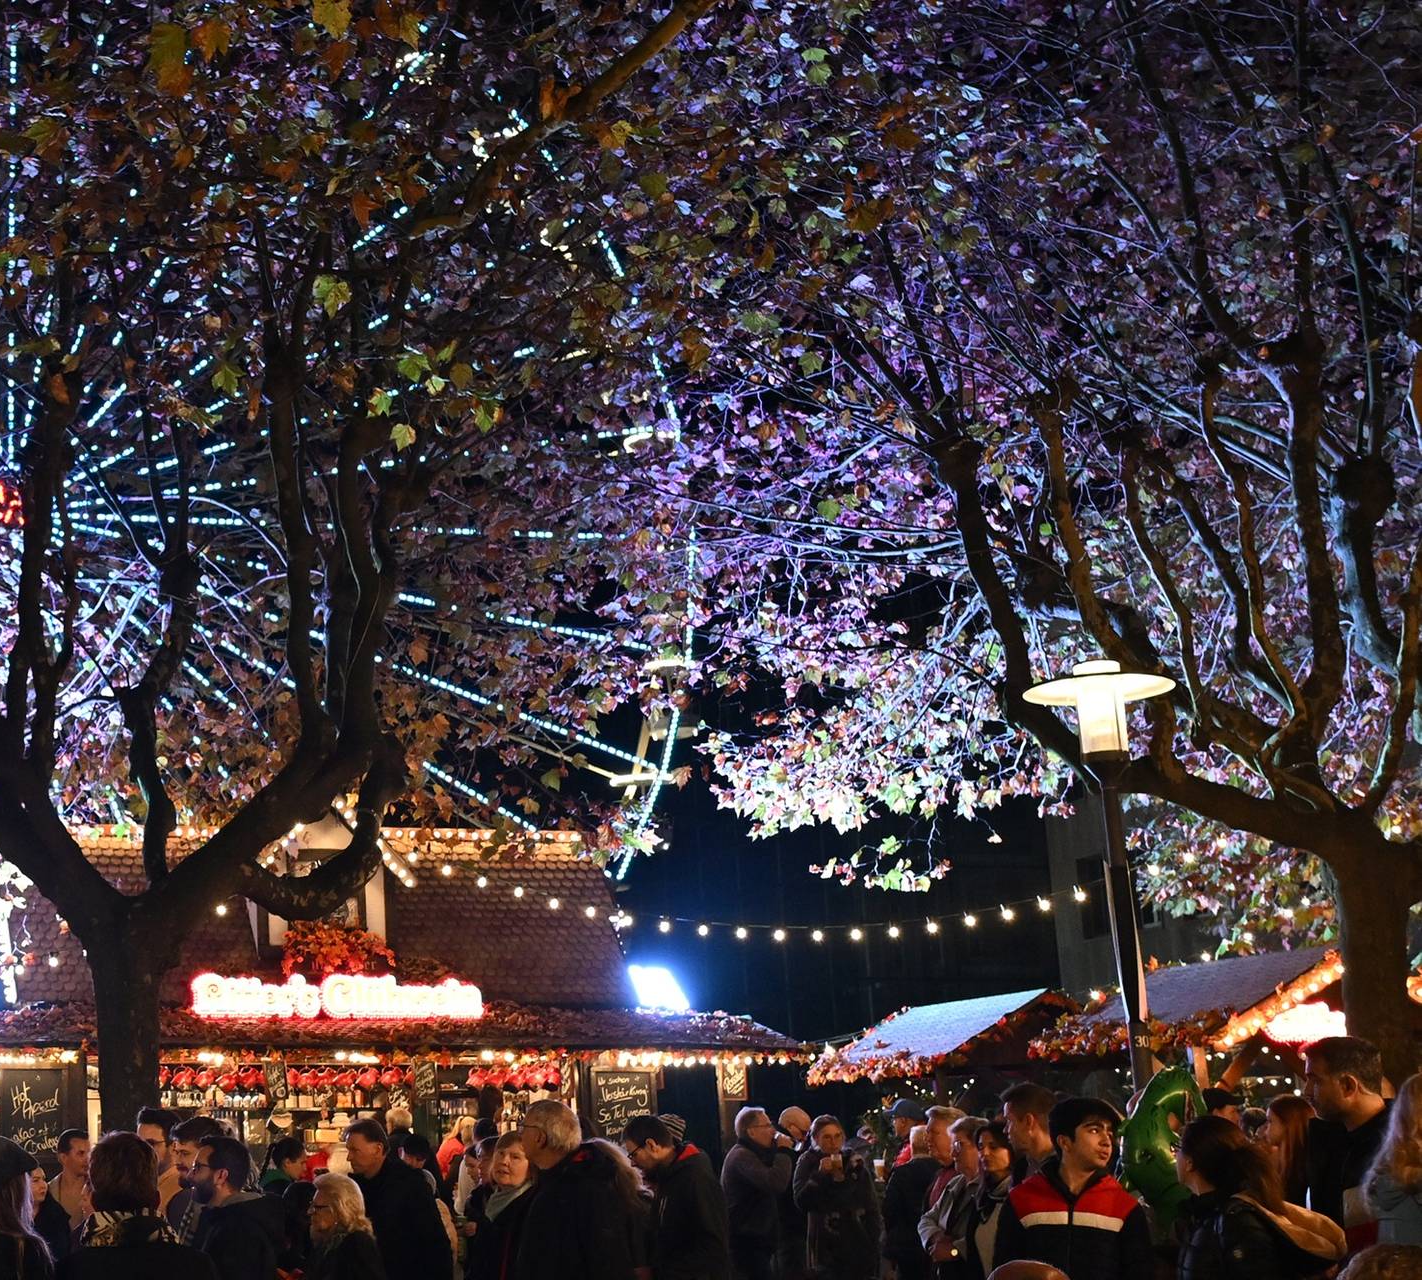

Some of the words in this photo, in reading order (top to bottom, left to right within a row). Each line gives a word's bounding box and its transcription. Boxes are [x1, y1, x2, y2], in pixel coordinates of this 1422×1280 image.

[323, 975, 483, 1018] Glühwein
[1134, 1035, 1149, 1047] 30
[10, 1080, 31, 1109] Hot
